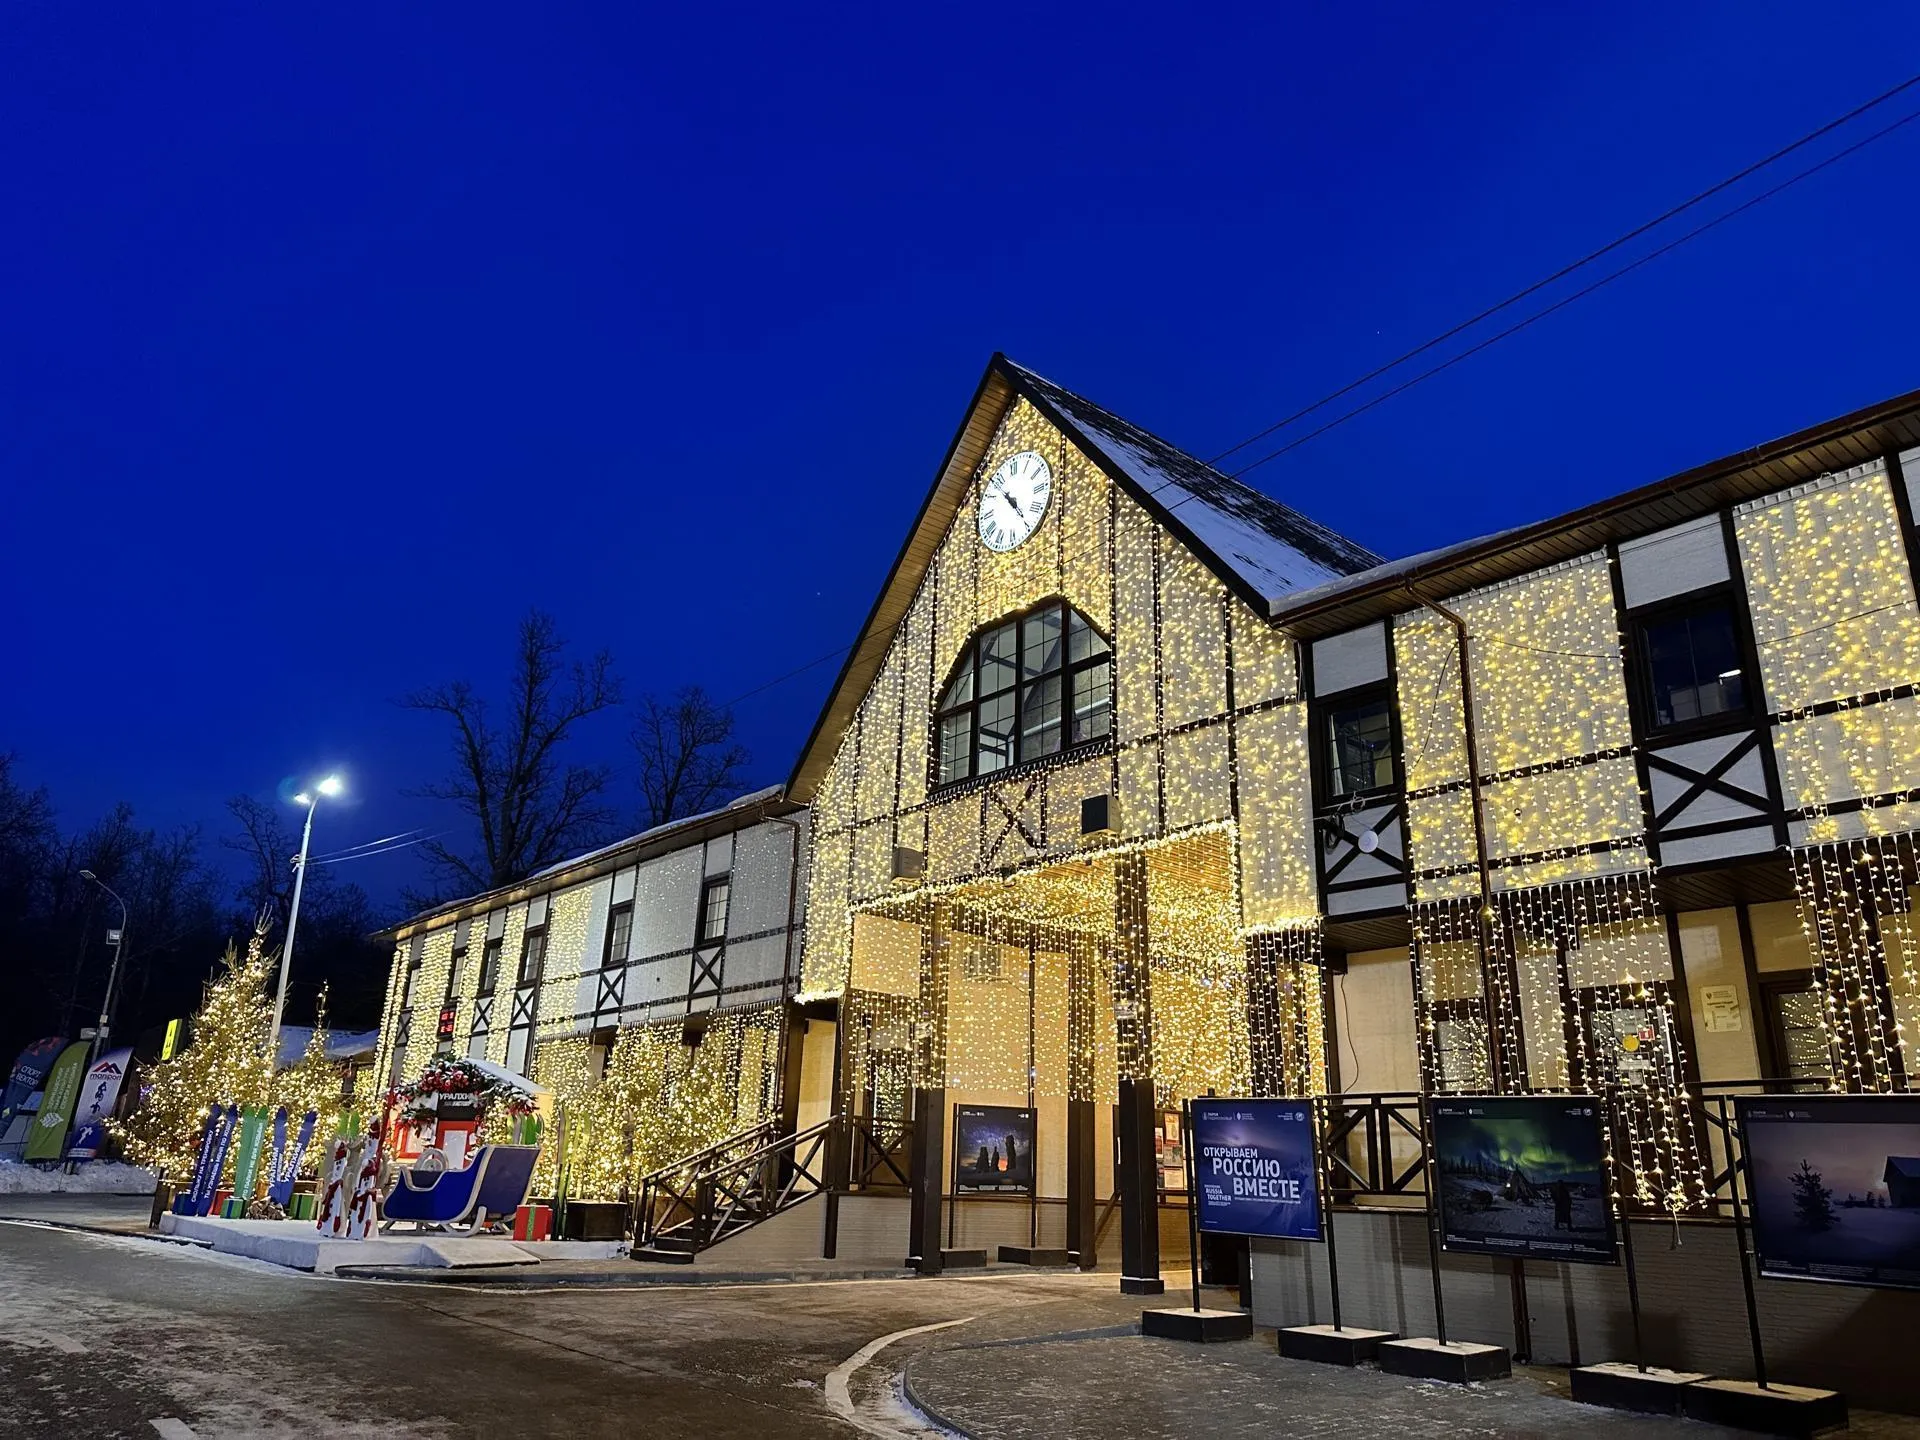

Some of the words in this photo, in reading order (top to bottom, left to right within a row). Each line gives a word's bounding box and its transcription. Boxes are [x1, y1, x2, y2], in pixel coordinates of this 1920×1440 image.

[21, 1066, 41, 1078] СПОРТ
[284, 1142, 302, 1182] УРАЛХИМ
[1204, 1147, 1258, 1158] ОТКРЫВАЕМ
[199, 1165, 204, 1174] НА
[270, 1148, 279, 1188] УРАЛХИМ
[1212, 1158, 1280, 1178] РОССИЮ
[1233, 1178, 1300, 1198] ВМЕСТЕ
